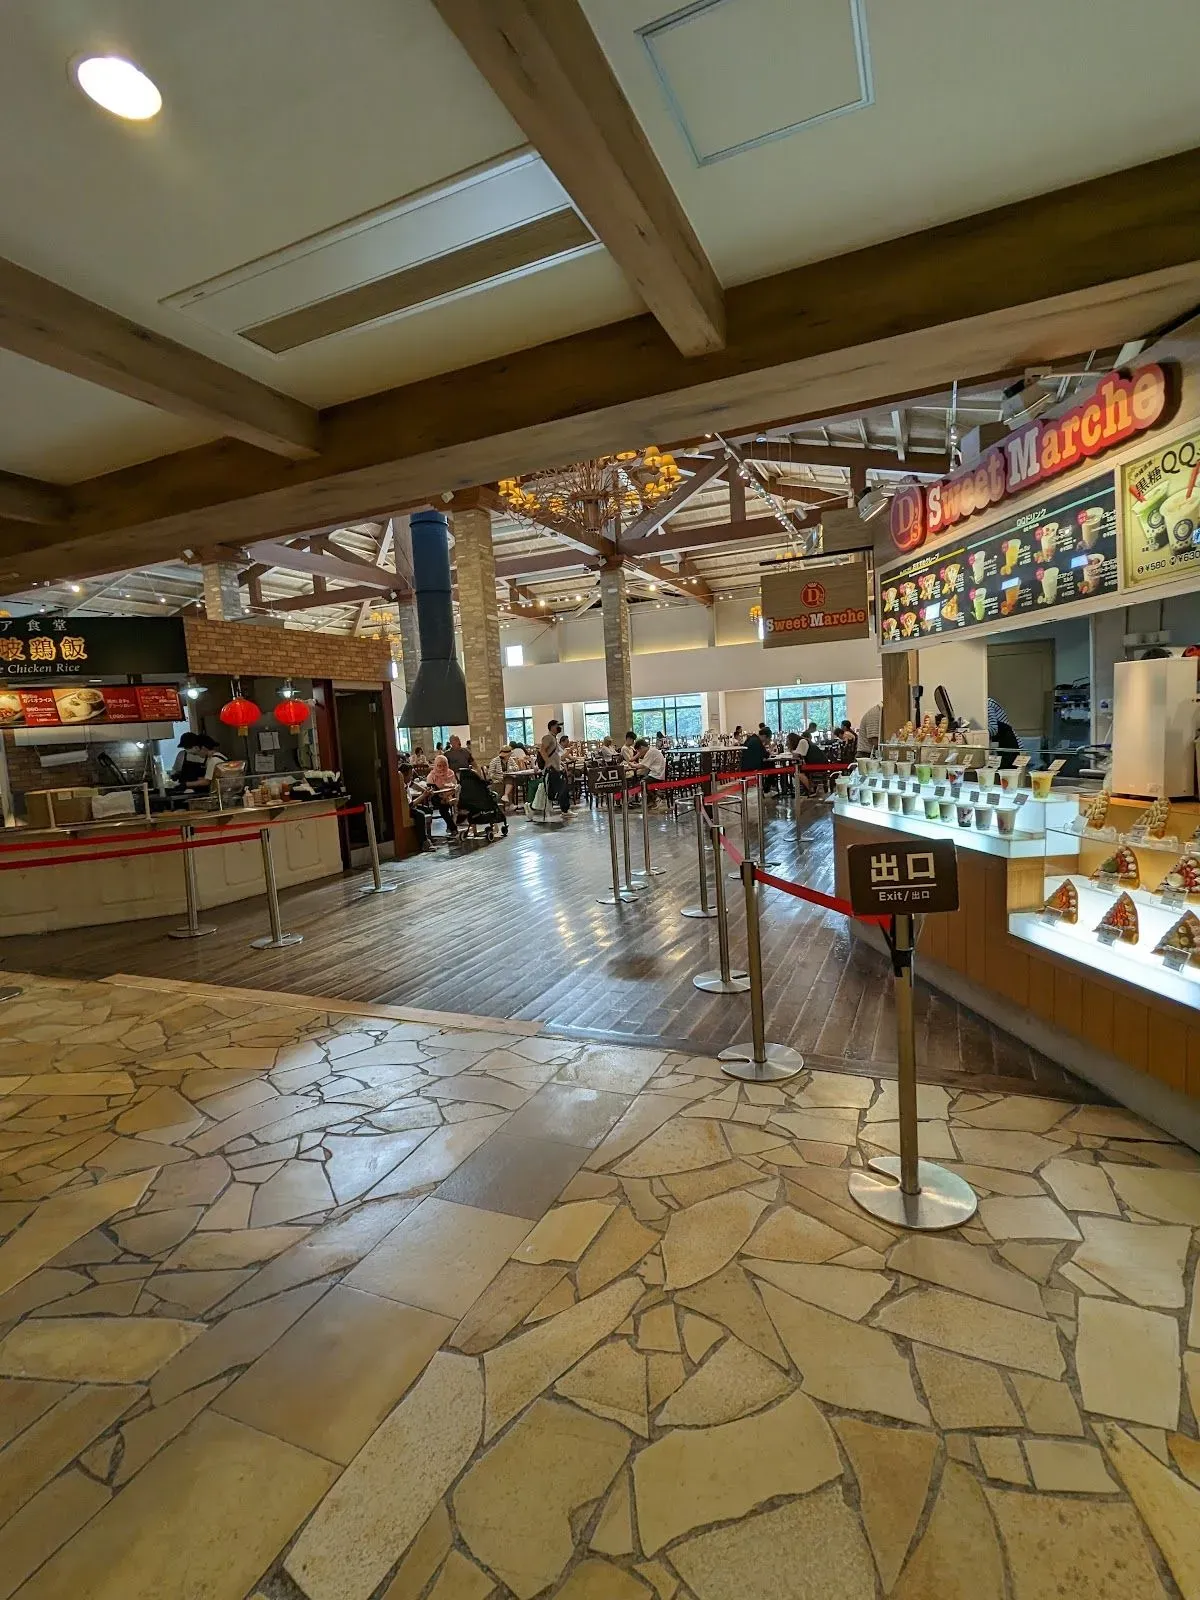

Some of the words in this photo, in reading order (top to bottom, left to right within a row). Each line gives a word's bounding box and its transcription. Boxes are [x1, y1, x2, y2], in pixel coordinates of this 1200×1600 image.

[928, 454, 1003, 528] Sweet
[1008, 372, 1164, 487] Marche
[1136, 465, 1162, 496] 黒糖
[1161, 442, 1200, 474] QQ
[1145, 559, 1166, 571] ¥580
[766, 614, 808, 632] Sweet
[809, 609, 865, 627] Marche
[7, 663, 52, 674] Chicken
[56, 663, 81, 672] Rice
[597, 770, 618, 781] 入口
[870, 852, 936, 883] 出口
